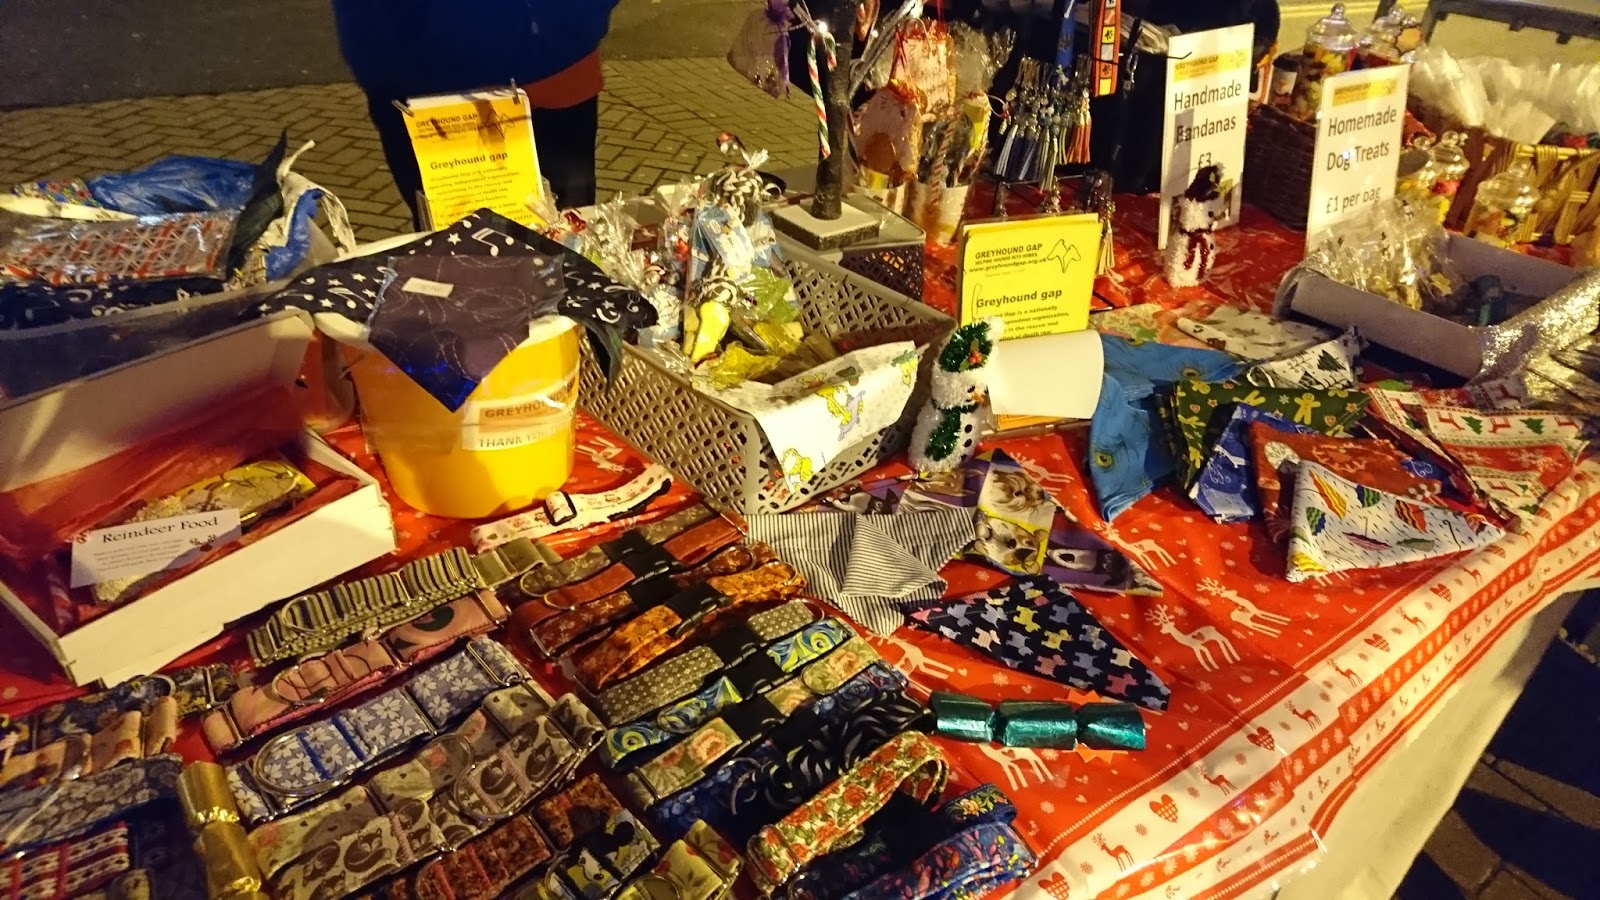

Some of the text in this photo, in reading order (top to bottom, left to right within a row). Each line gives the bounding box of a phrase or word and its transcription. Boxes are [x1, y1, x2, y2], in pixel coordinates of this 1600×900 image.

[1174, 79, 1242, 112] Handmade
[416, 115, 461, 128] GREHOUND
[1175, 115, 1236, 144] Bandanas
[1328, 105, 1397, 137] Homemade
[430, 151, 508, 171] Greyhound gap
[1327, 140, 1390, 172] Dog Treats
[1325, 196, 1339, 214] £1
[1342, 193, 1361, 213] per
[975, 243, 1043, 260] GREYHOUND GAP
[976, 288, 1062, 309] Greyhound gap
[479, 436, 522, 448] THANK
[102, 516, 219, 544] Reindeer Food
